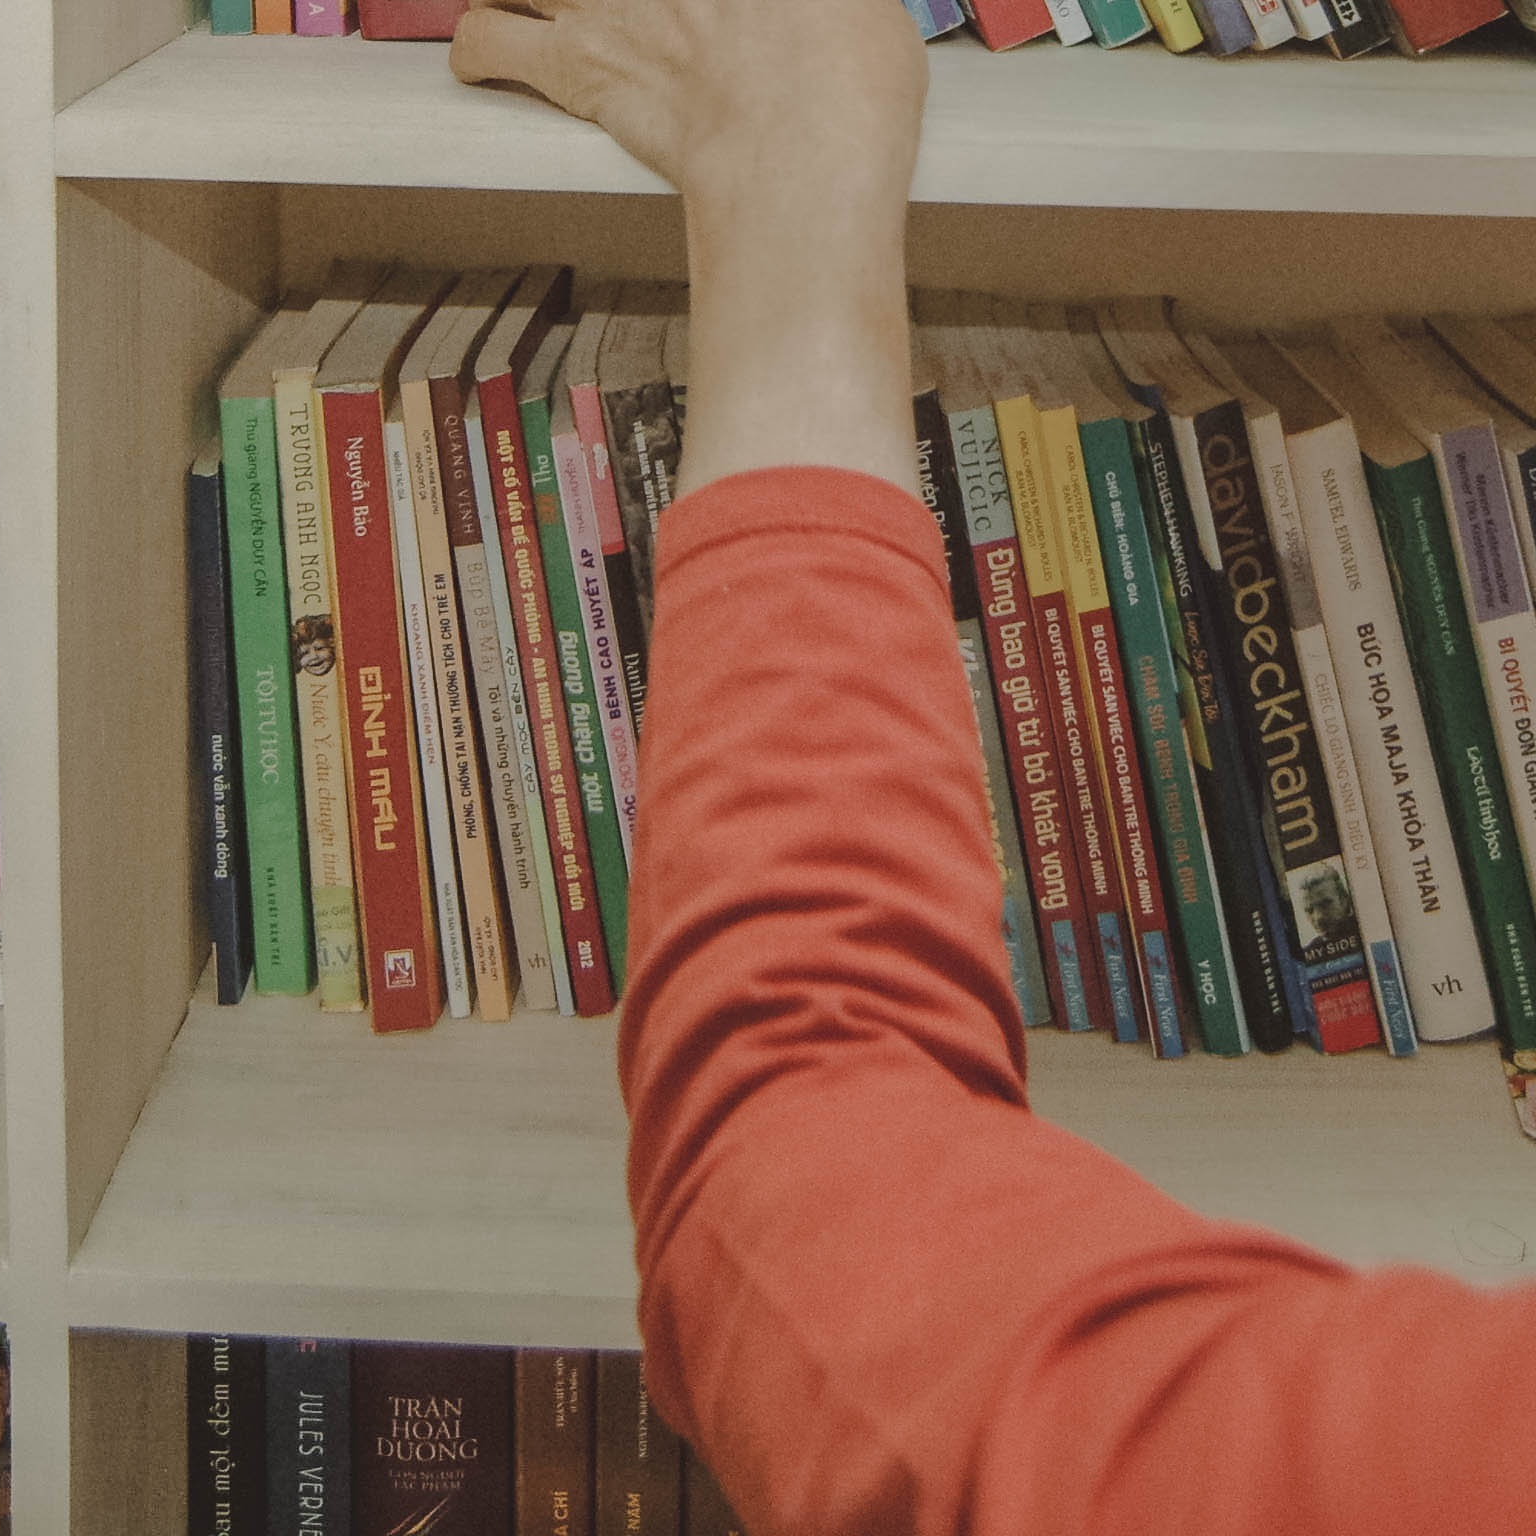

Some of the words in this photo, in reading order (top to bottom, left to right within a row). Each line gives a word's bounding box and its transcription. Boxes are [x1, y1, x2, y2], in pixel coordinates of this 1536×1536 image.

[958, 419, 991, 531] VUJICIC
[296, 502, 317, 544] ANH
[596, 636, 612, 668] CAO
[999, 621, 1026, 670] bao
[1234, 580, 1318, 850] beckham
[1381, 724, 1409, 786] MAJA
[298, 1391, 324, 1456] JULES
